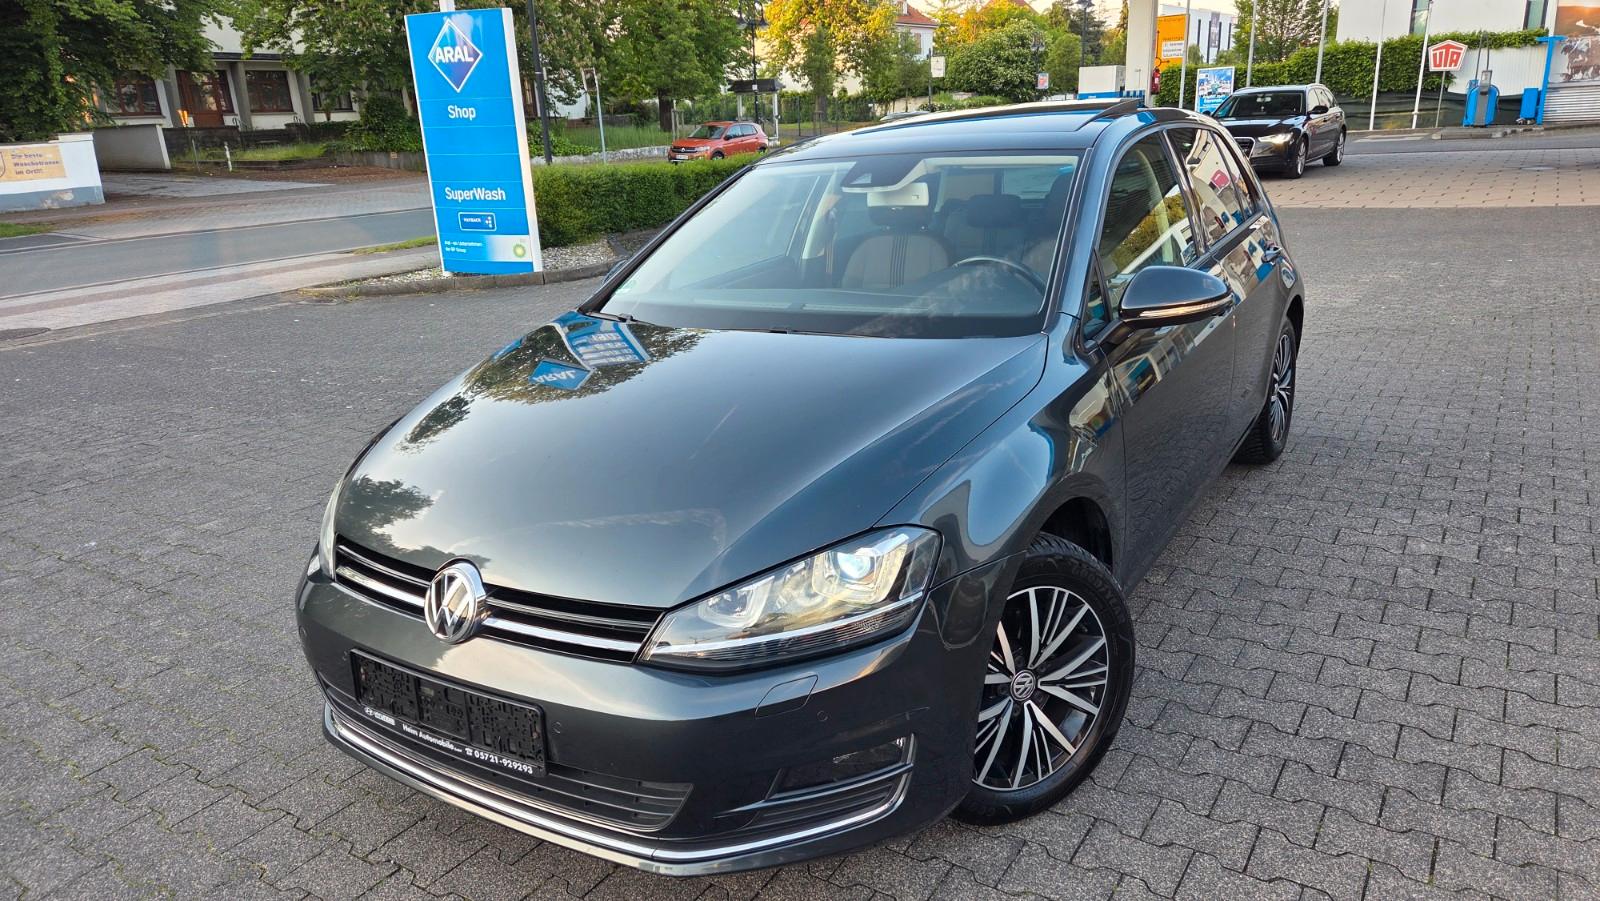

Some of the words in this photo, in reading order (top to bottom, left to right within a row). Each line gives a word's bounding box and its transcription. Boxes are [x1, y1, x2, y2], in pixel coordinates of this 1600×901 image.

[436, 45, 474, 63] ARAL
[1432, 43, 1464, 68] UTA
[447, 104, 476, 121] Shop
[445, 186, 506, 203] SuperWash
[418, 730, 455, 750] Automobile
[474, 750, 533, 774] 05721-929293
